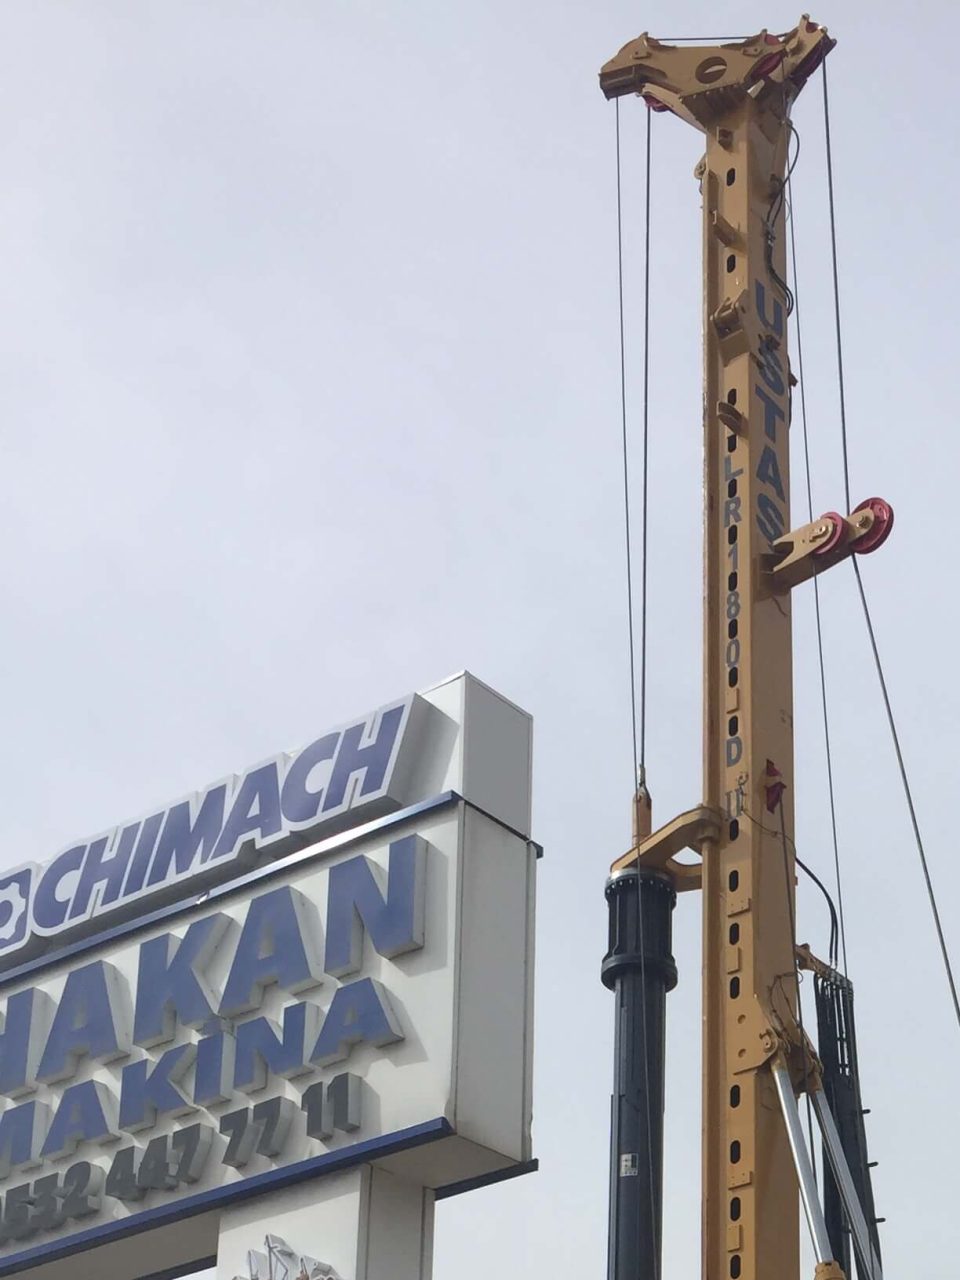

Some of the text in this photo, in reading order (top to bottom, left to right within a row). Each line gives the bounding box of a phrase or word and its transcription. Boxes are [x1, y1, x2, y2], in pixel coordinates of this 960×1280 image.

[106, 1123, 201, 1200] 447
[219, 1096, 281, 1167] 77
[301, 1072, 350, 1142] 11
